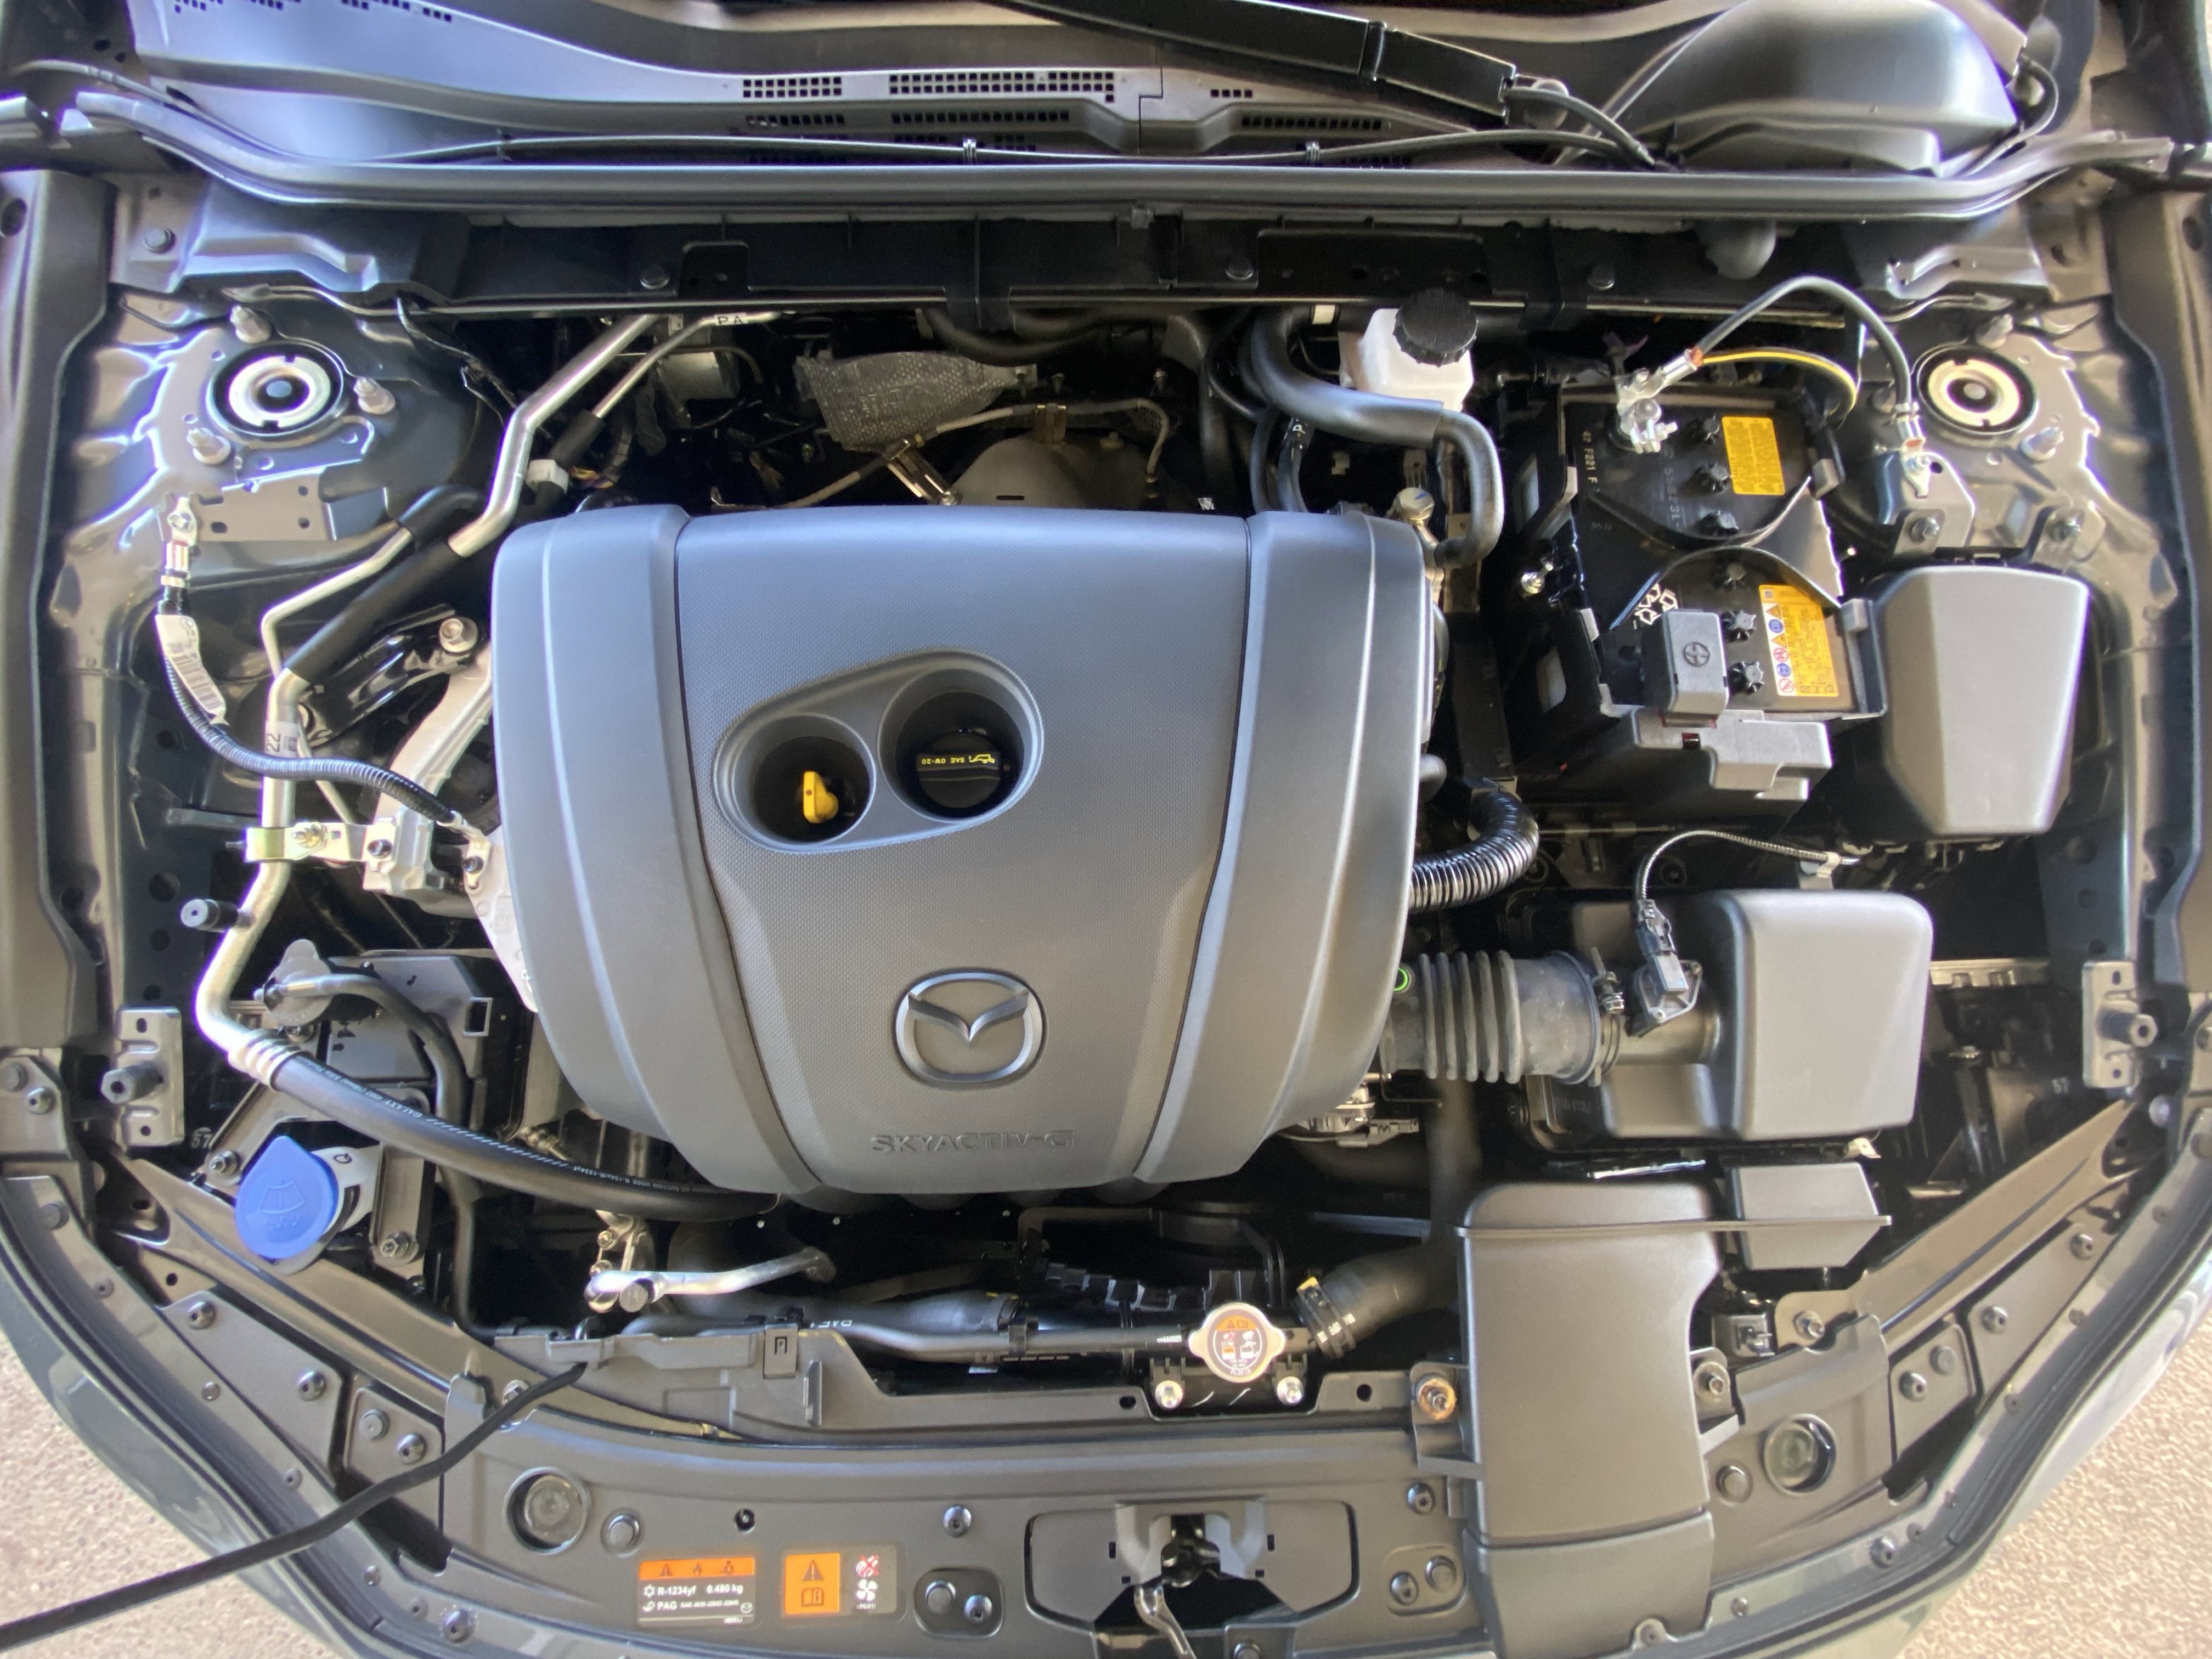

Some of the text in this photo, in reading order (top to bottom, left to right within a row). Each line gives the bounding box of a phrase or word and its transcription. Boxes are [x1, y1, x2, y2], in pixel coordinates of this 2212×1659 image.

[871, 1129, 1076, 1153] SKYACTIV-G
[657, 1584, 697, 1597] R-1234yf
[732, 1583, 744, 1595] kg
[657, 1600, 678, 1611] PAG
